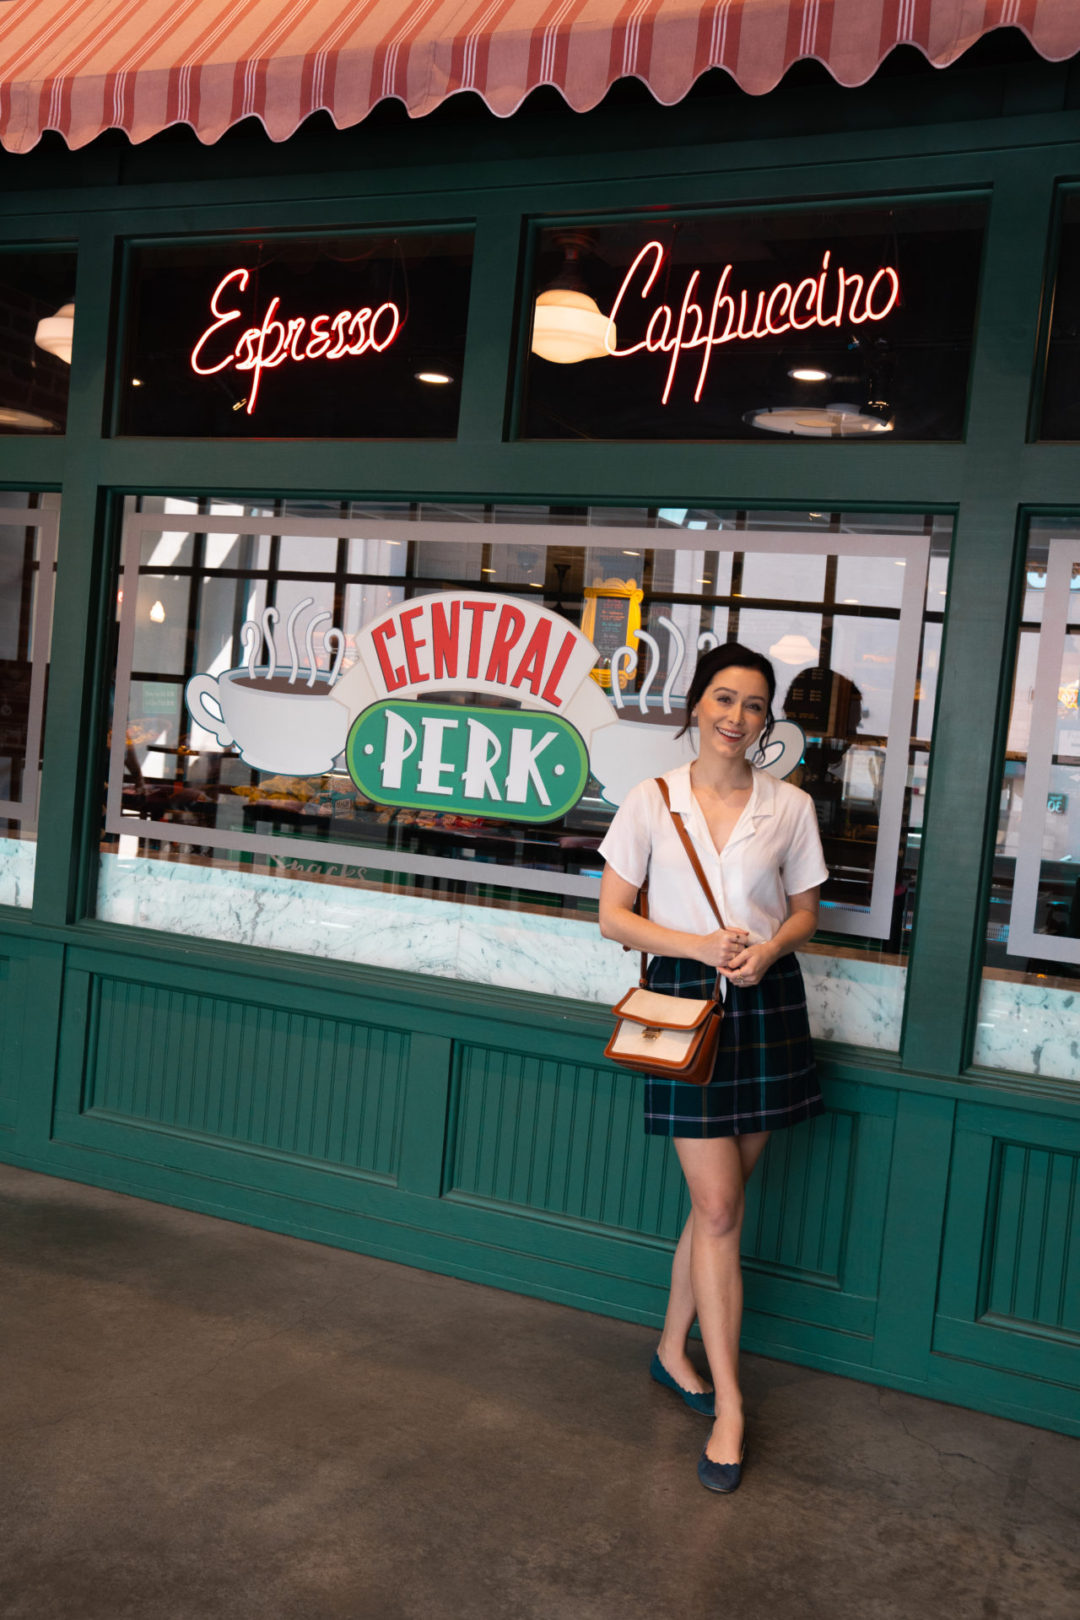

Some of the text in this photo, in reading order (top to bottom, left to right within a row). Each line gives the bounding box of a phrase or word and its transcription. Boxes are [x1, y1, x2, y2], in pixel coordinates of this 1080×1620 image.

[190, 267, 400, 414] Espresso
[603, 240, 900, 404] Cappuccino
[370, 600, 578, 708] CENTRAL
[380, 709, 559, 806] PERK
